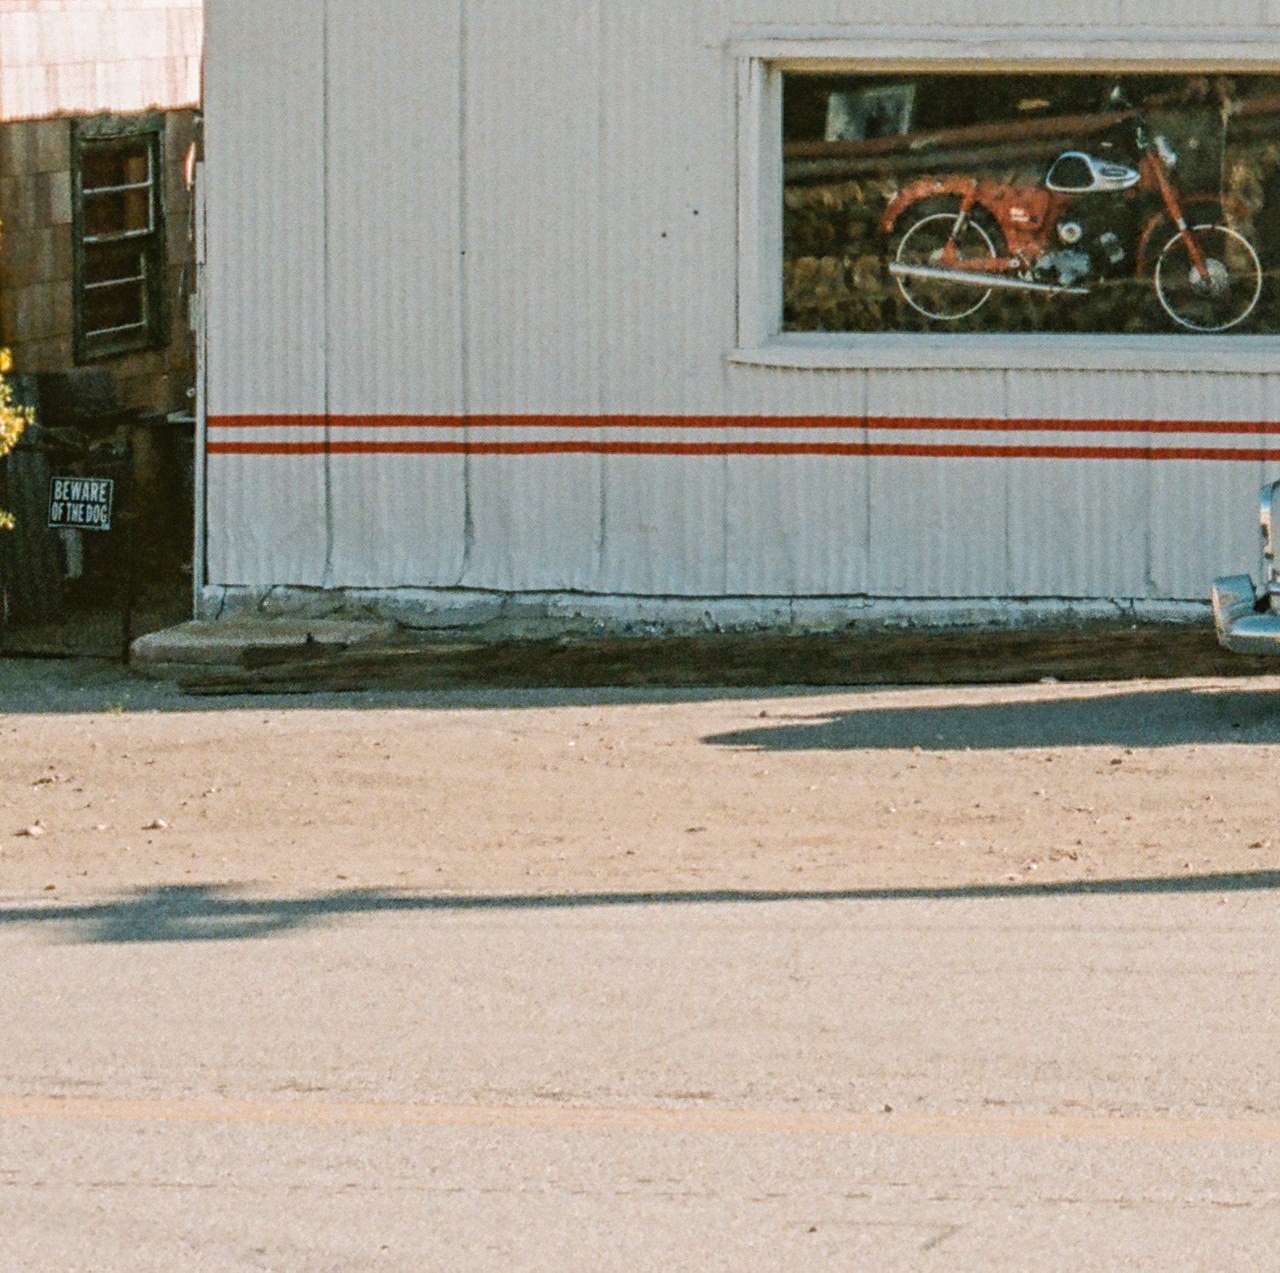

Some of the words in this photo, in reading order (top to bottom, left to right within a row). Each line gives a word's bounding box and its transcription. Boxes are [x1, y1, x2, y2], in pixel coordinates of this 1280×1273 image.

[54, 480, 108, 503] BEWARE
[51, 501, 65, 522] OF
[66, 501, 85, 523] THE
[86, 503, 108, 524] DOG
